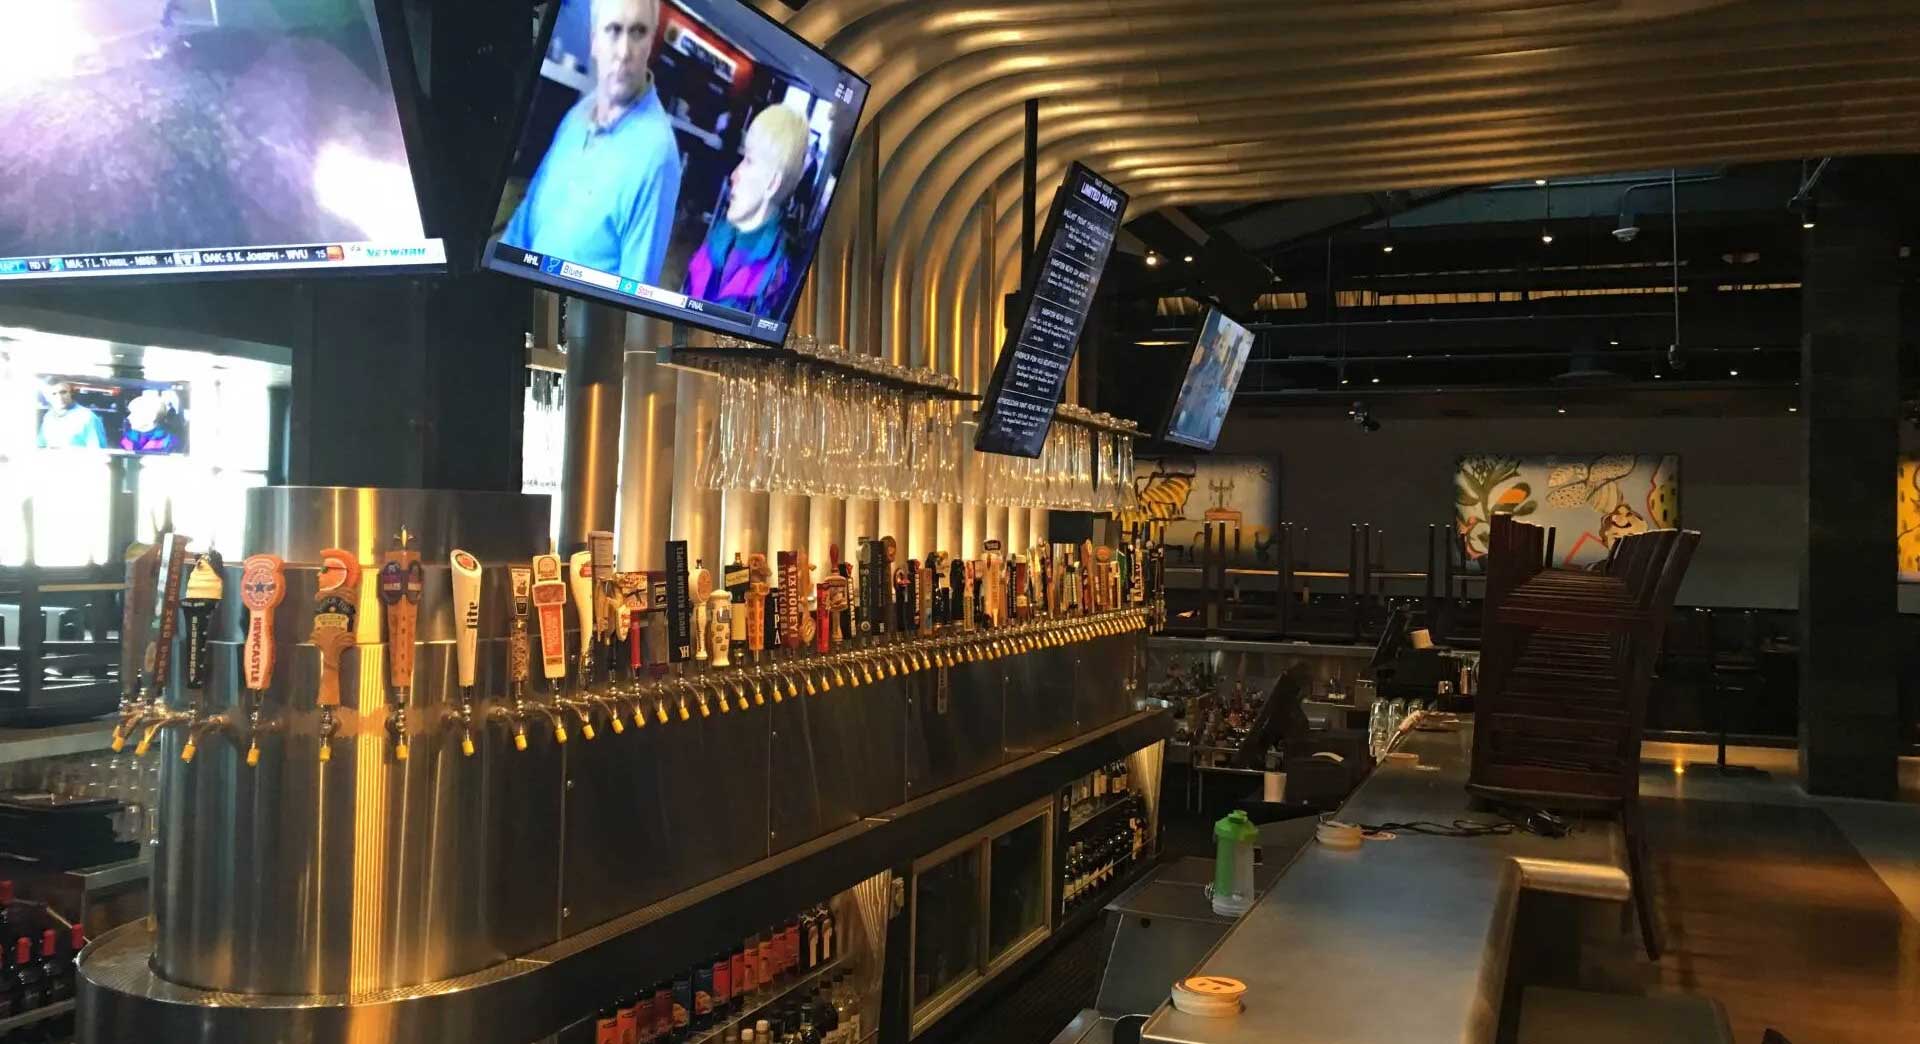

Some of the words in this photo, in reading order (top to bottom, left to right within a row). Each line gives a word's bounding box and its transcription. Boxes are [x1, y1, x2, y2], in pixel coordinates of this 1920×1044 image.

[1080, 181, 1101, 202] LIMITED
[1099, 193, 1118, 213] DRAFTS
[163, 256, 173, 265] 14
[286, 249, 308, 260] WVU
[523, 253, 539, 266] NHL
[563, 264, 583, 279] Blues
[687, 300, 704, 312] FINAL
[788, 588, 799, 634] HONEY
[251, 616, 262, 683] NEWCASTLE
